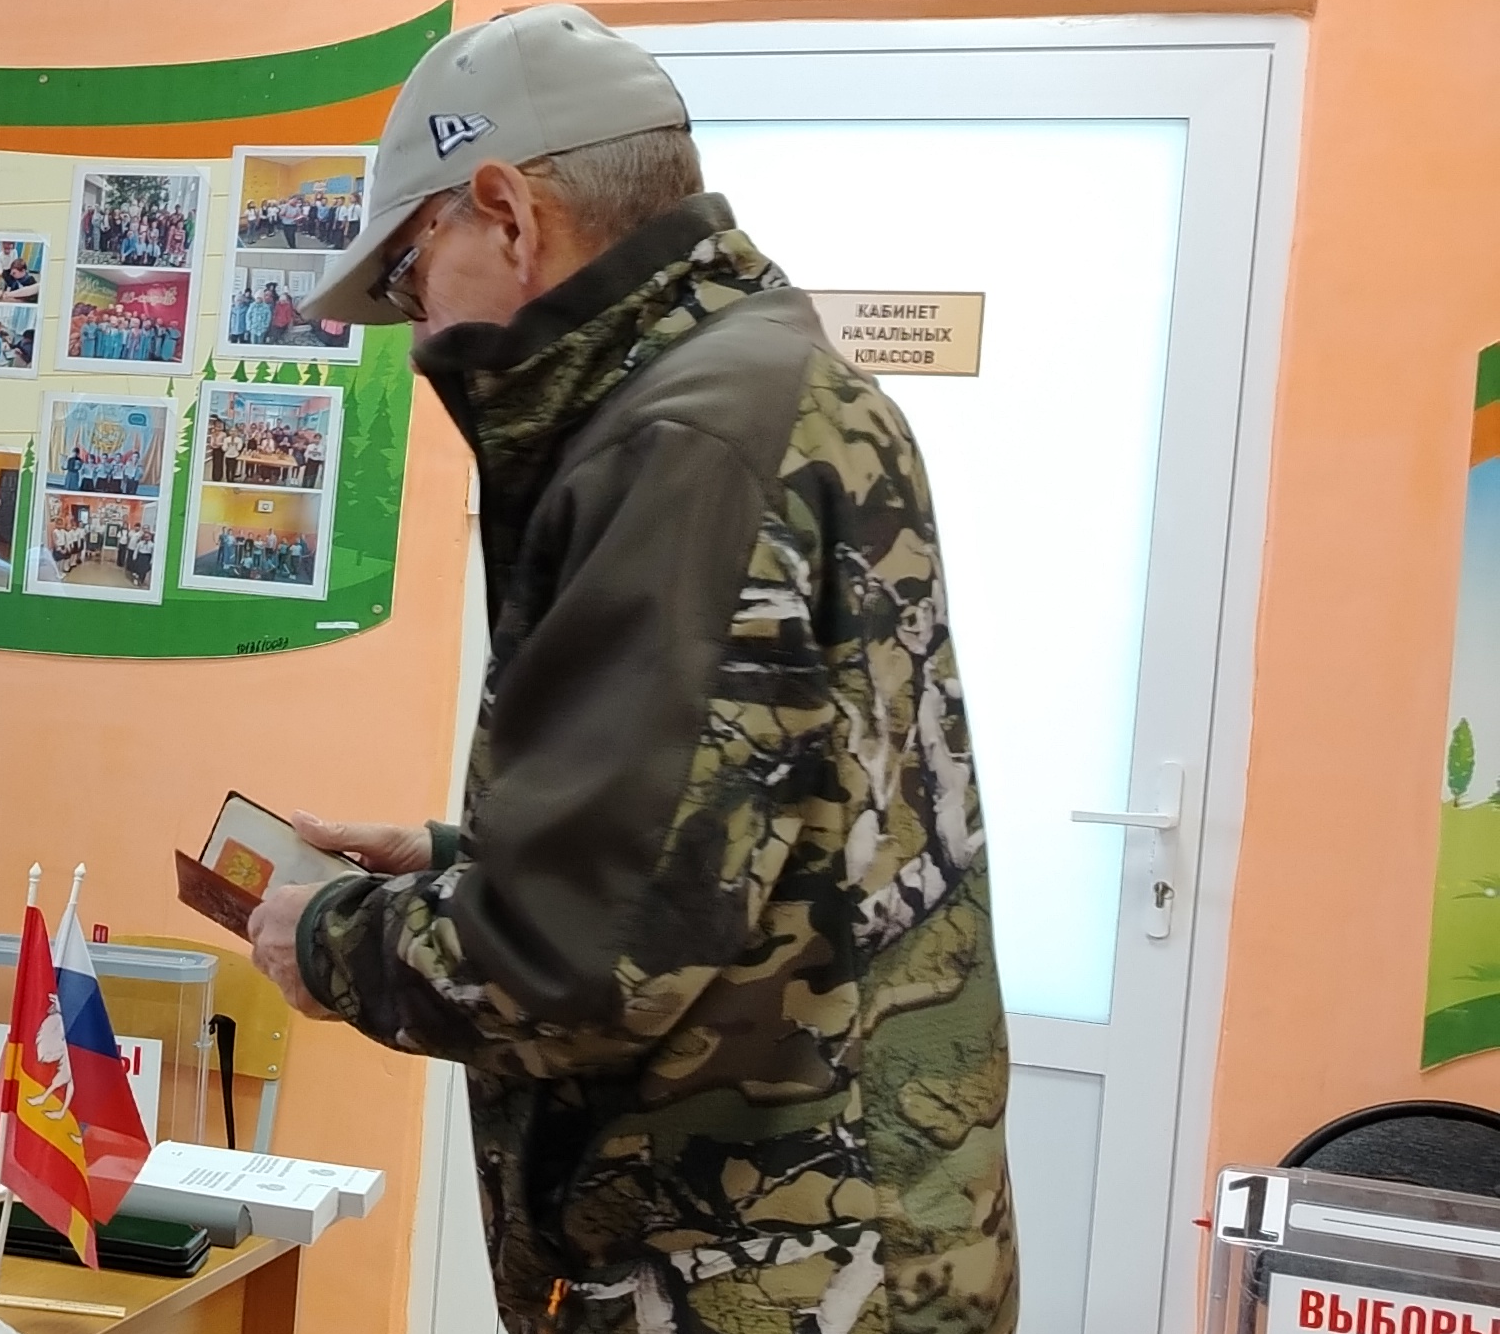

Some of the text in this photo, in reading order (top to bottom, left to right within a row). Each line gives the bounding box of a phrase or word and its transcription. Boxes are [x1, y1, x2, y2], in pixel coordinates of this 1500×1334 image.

[856, 303, 940, 320] КАБИНЕТ
[841, 325, 953, 343] НАЧАЛЬНЫХ
[854, 348, 935, 365] КЛАССОВ
[1222, 1175, 1280, 1242] 1
